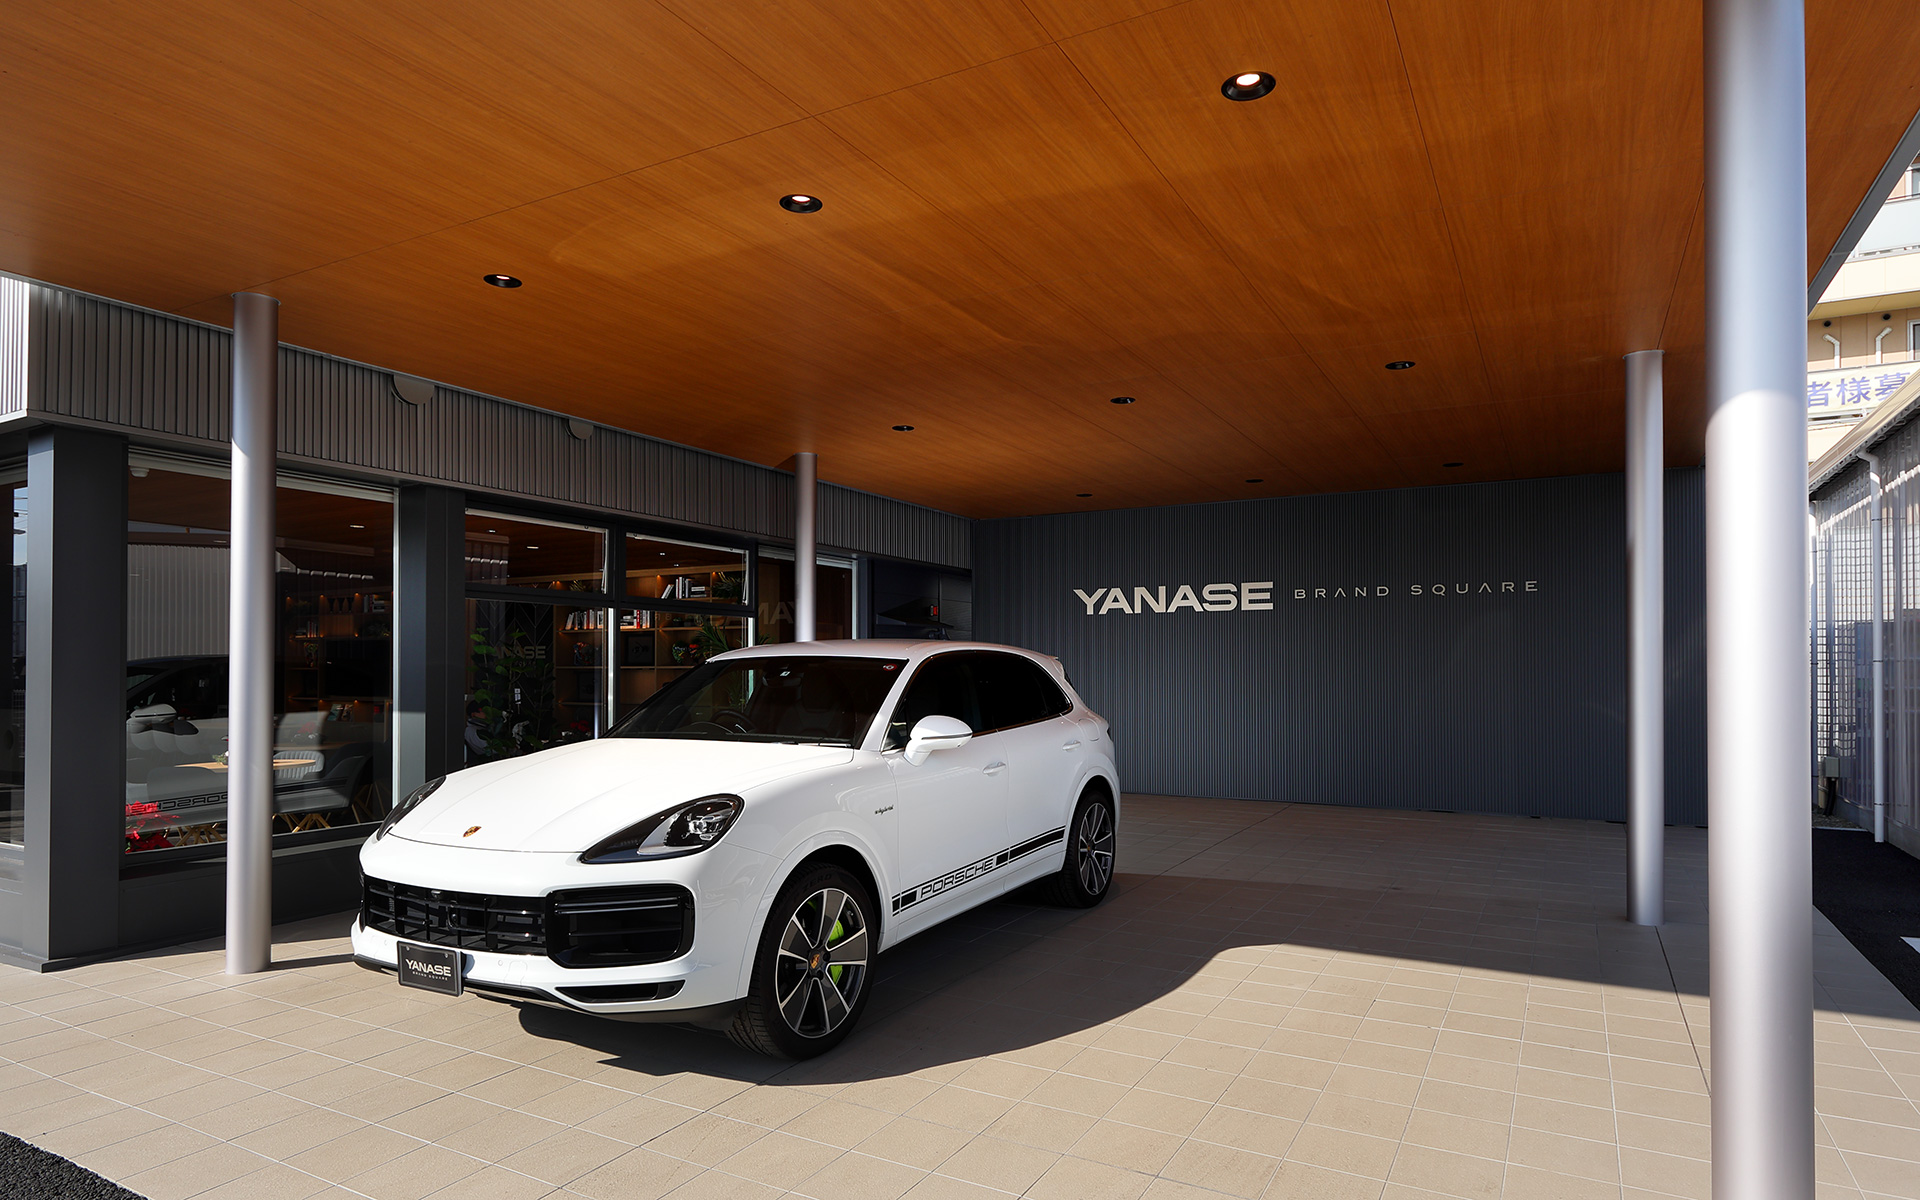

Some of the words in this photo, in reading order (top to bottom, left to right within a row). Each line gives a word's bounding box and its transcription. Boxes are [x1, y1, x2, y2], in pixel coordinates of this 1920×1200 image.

[1073, 581, 1274, 615] YANASE
[1294, 586, 1389, 599] BRAND
[1410, 580, 1538, 597] SQUARE
[920, 858, 994, 898] PORSCHE
[405, 958, 452, 977] YANASE
